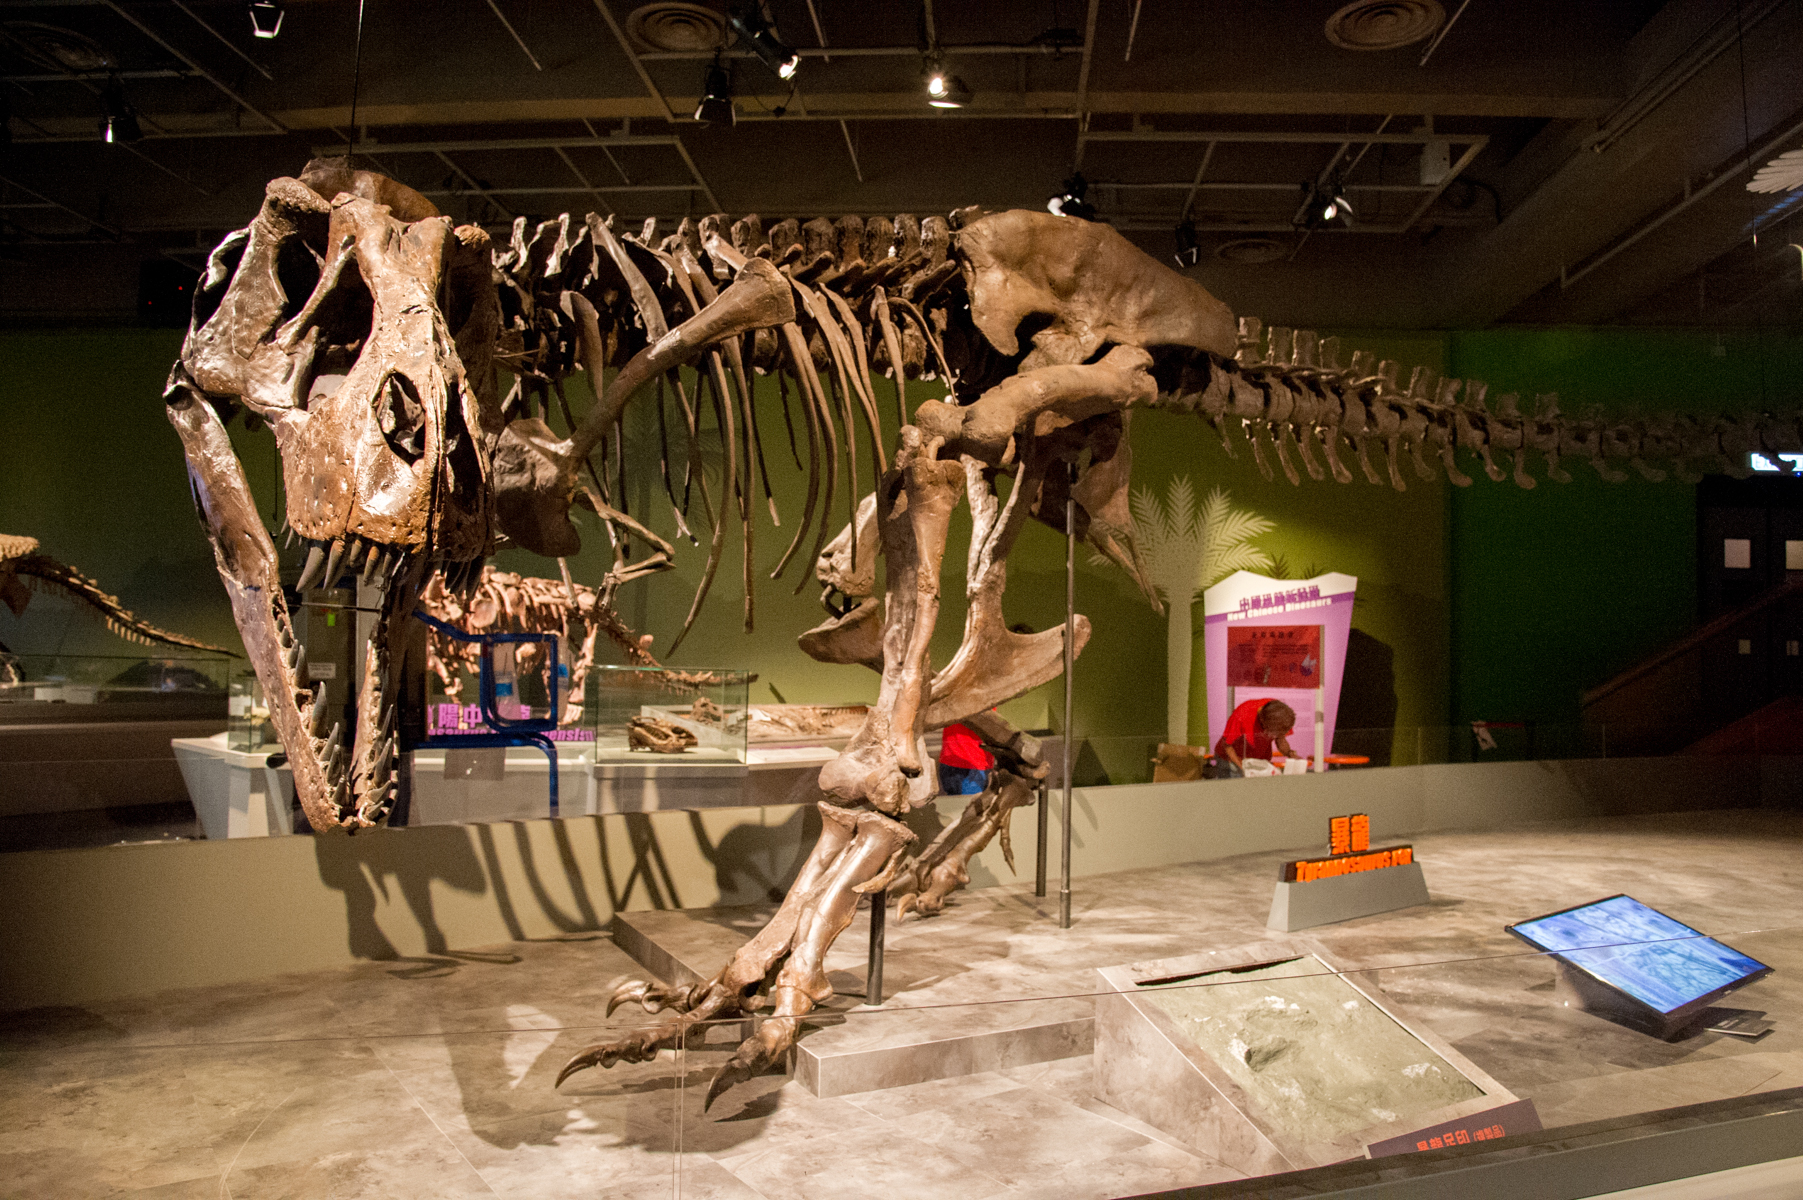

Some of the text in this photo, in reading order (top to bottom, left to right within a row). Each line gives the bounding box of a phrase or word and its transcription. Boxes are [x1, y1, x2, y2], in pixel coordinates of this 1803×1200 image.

[1227, 598, 1332, 622] New Chinese Dinosaurs
[1331, 815, 1369, 854] 暴龍
[1296, 852, 1391, 882] Tyrannosaurus
